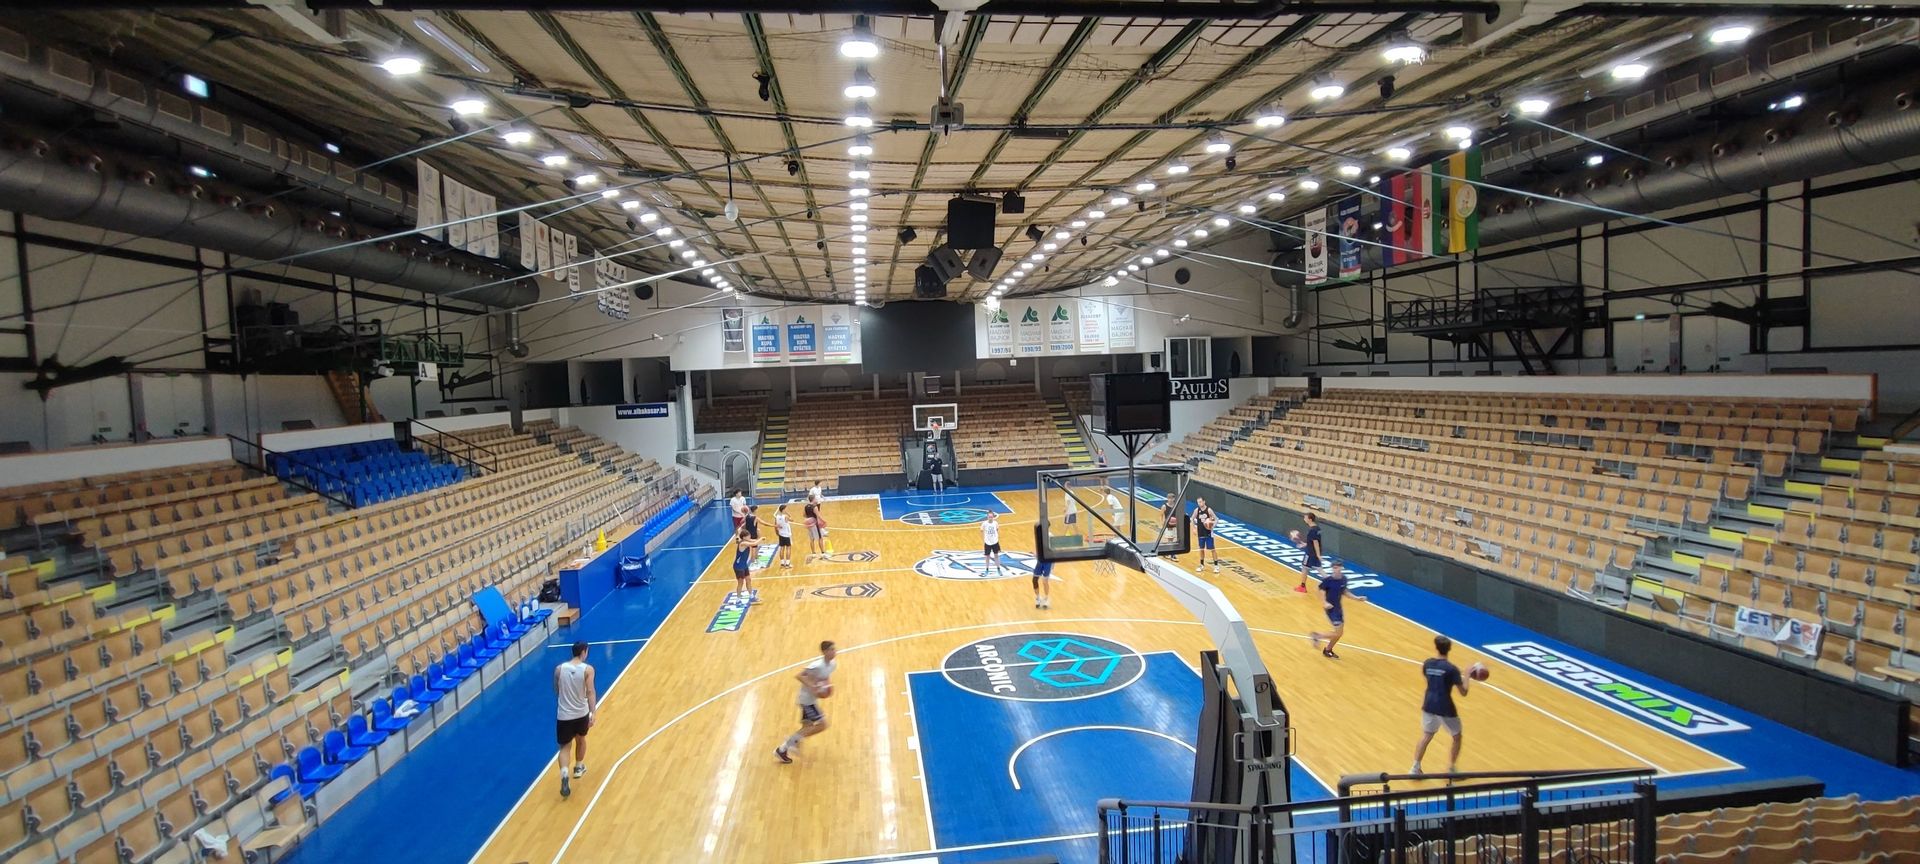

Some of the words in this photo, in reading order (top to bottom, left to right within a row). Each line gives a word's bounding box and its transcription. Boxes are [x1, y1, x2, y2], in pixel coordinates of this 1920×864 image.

[420, 363, 428, 378] A
[1170, 379, 1228, 395] PAULUS
[975, 644, 1017, 693] ARCONIC
